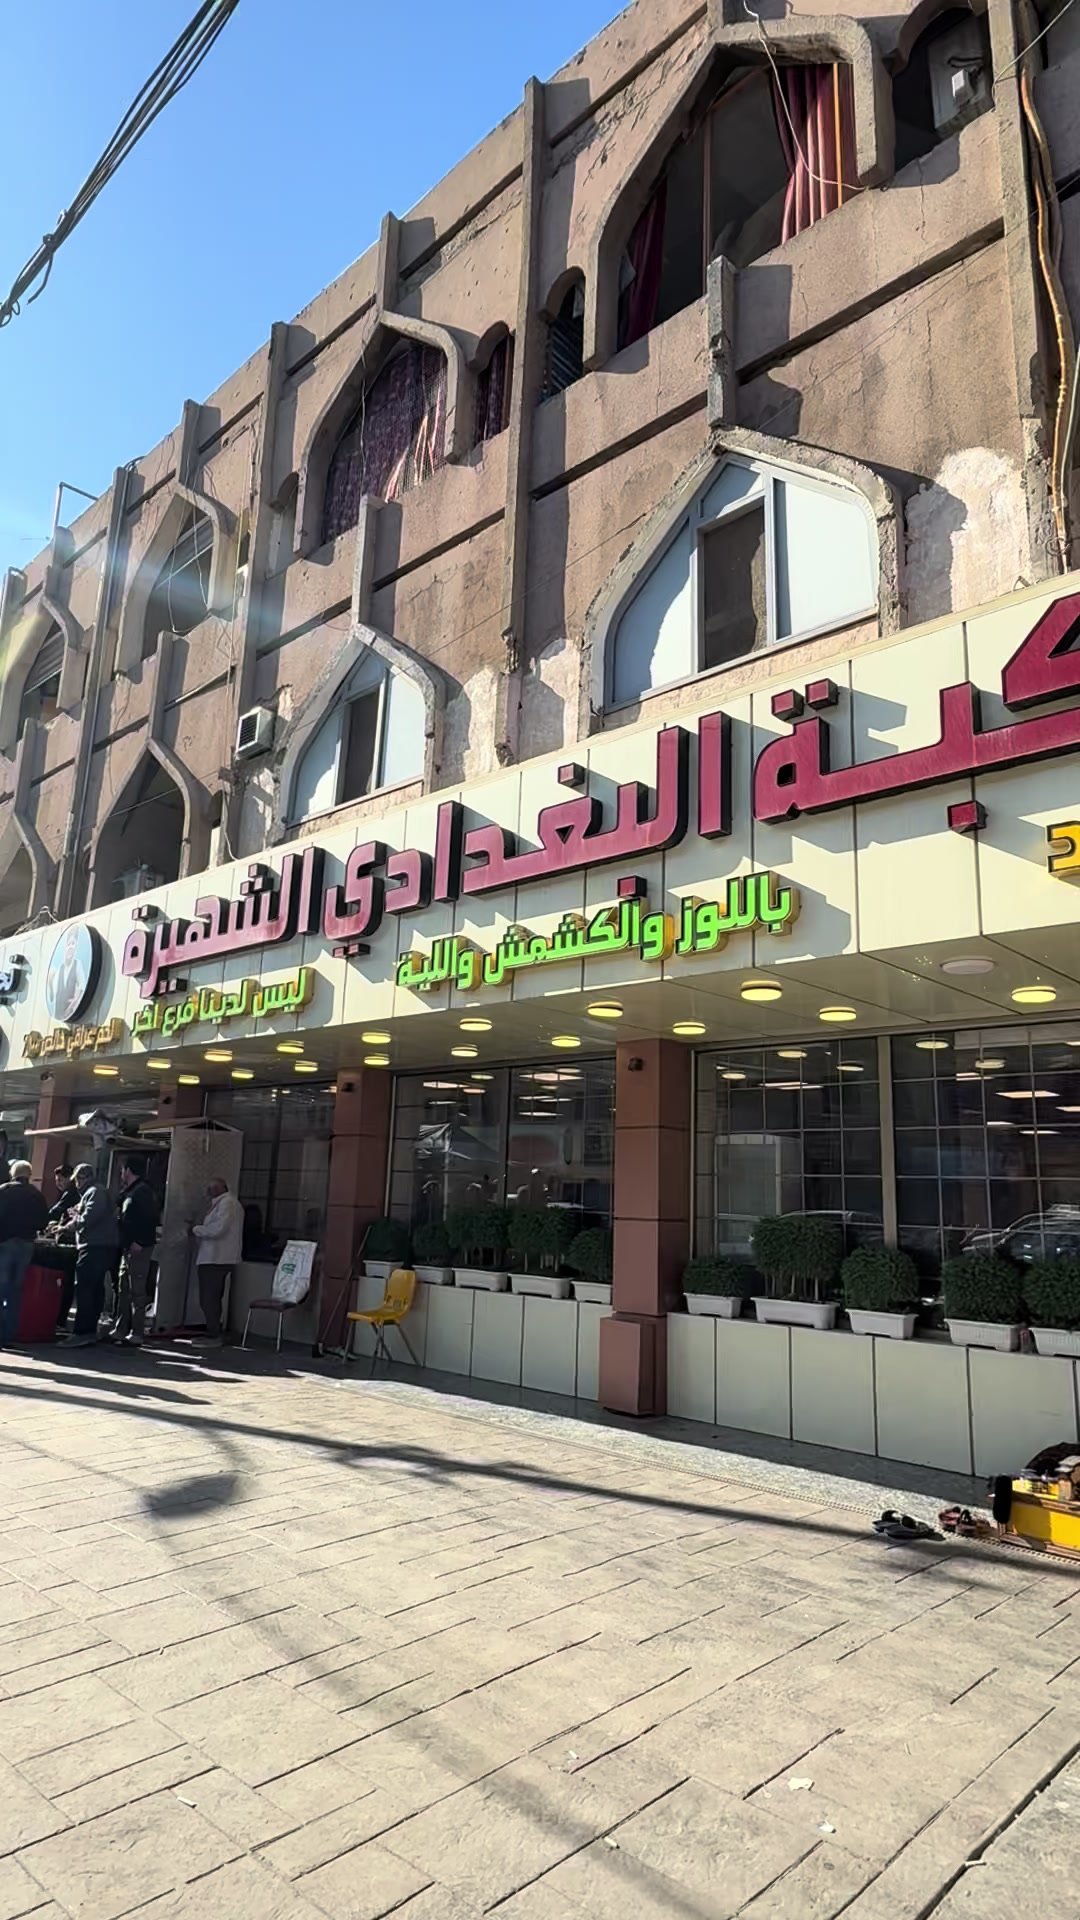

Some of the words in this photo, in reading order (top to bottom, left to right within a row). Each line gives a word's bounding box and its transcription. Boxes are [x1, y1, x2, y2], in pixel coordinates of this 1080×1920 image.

[324, 710, 729, 958] البغدادي
[122, 846, 322, 999] الشهيرة
[481, 897, 667, 987] والكشمش
[676, 871, 795, 955] باللوز
[161, 997, 195, 1037] فرع
[199, 979, 250, 1025] لدينا
[252, 966, 309, 1018] ليس
[93, 1017, 118, 1053] لحم
